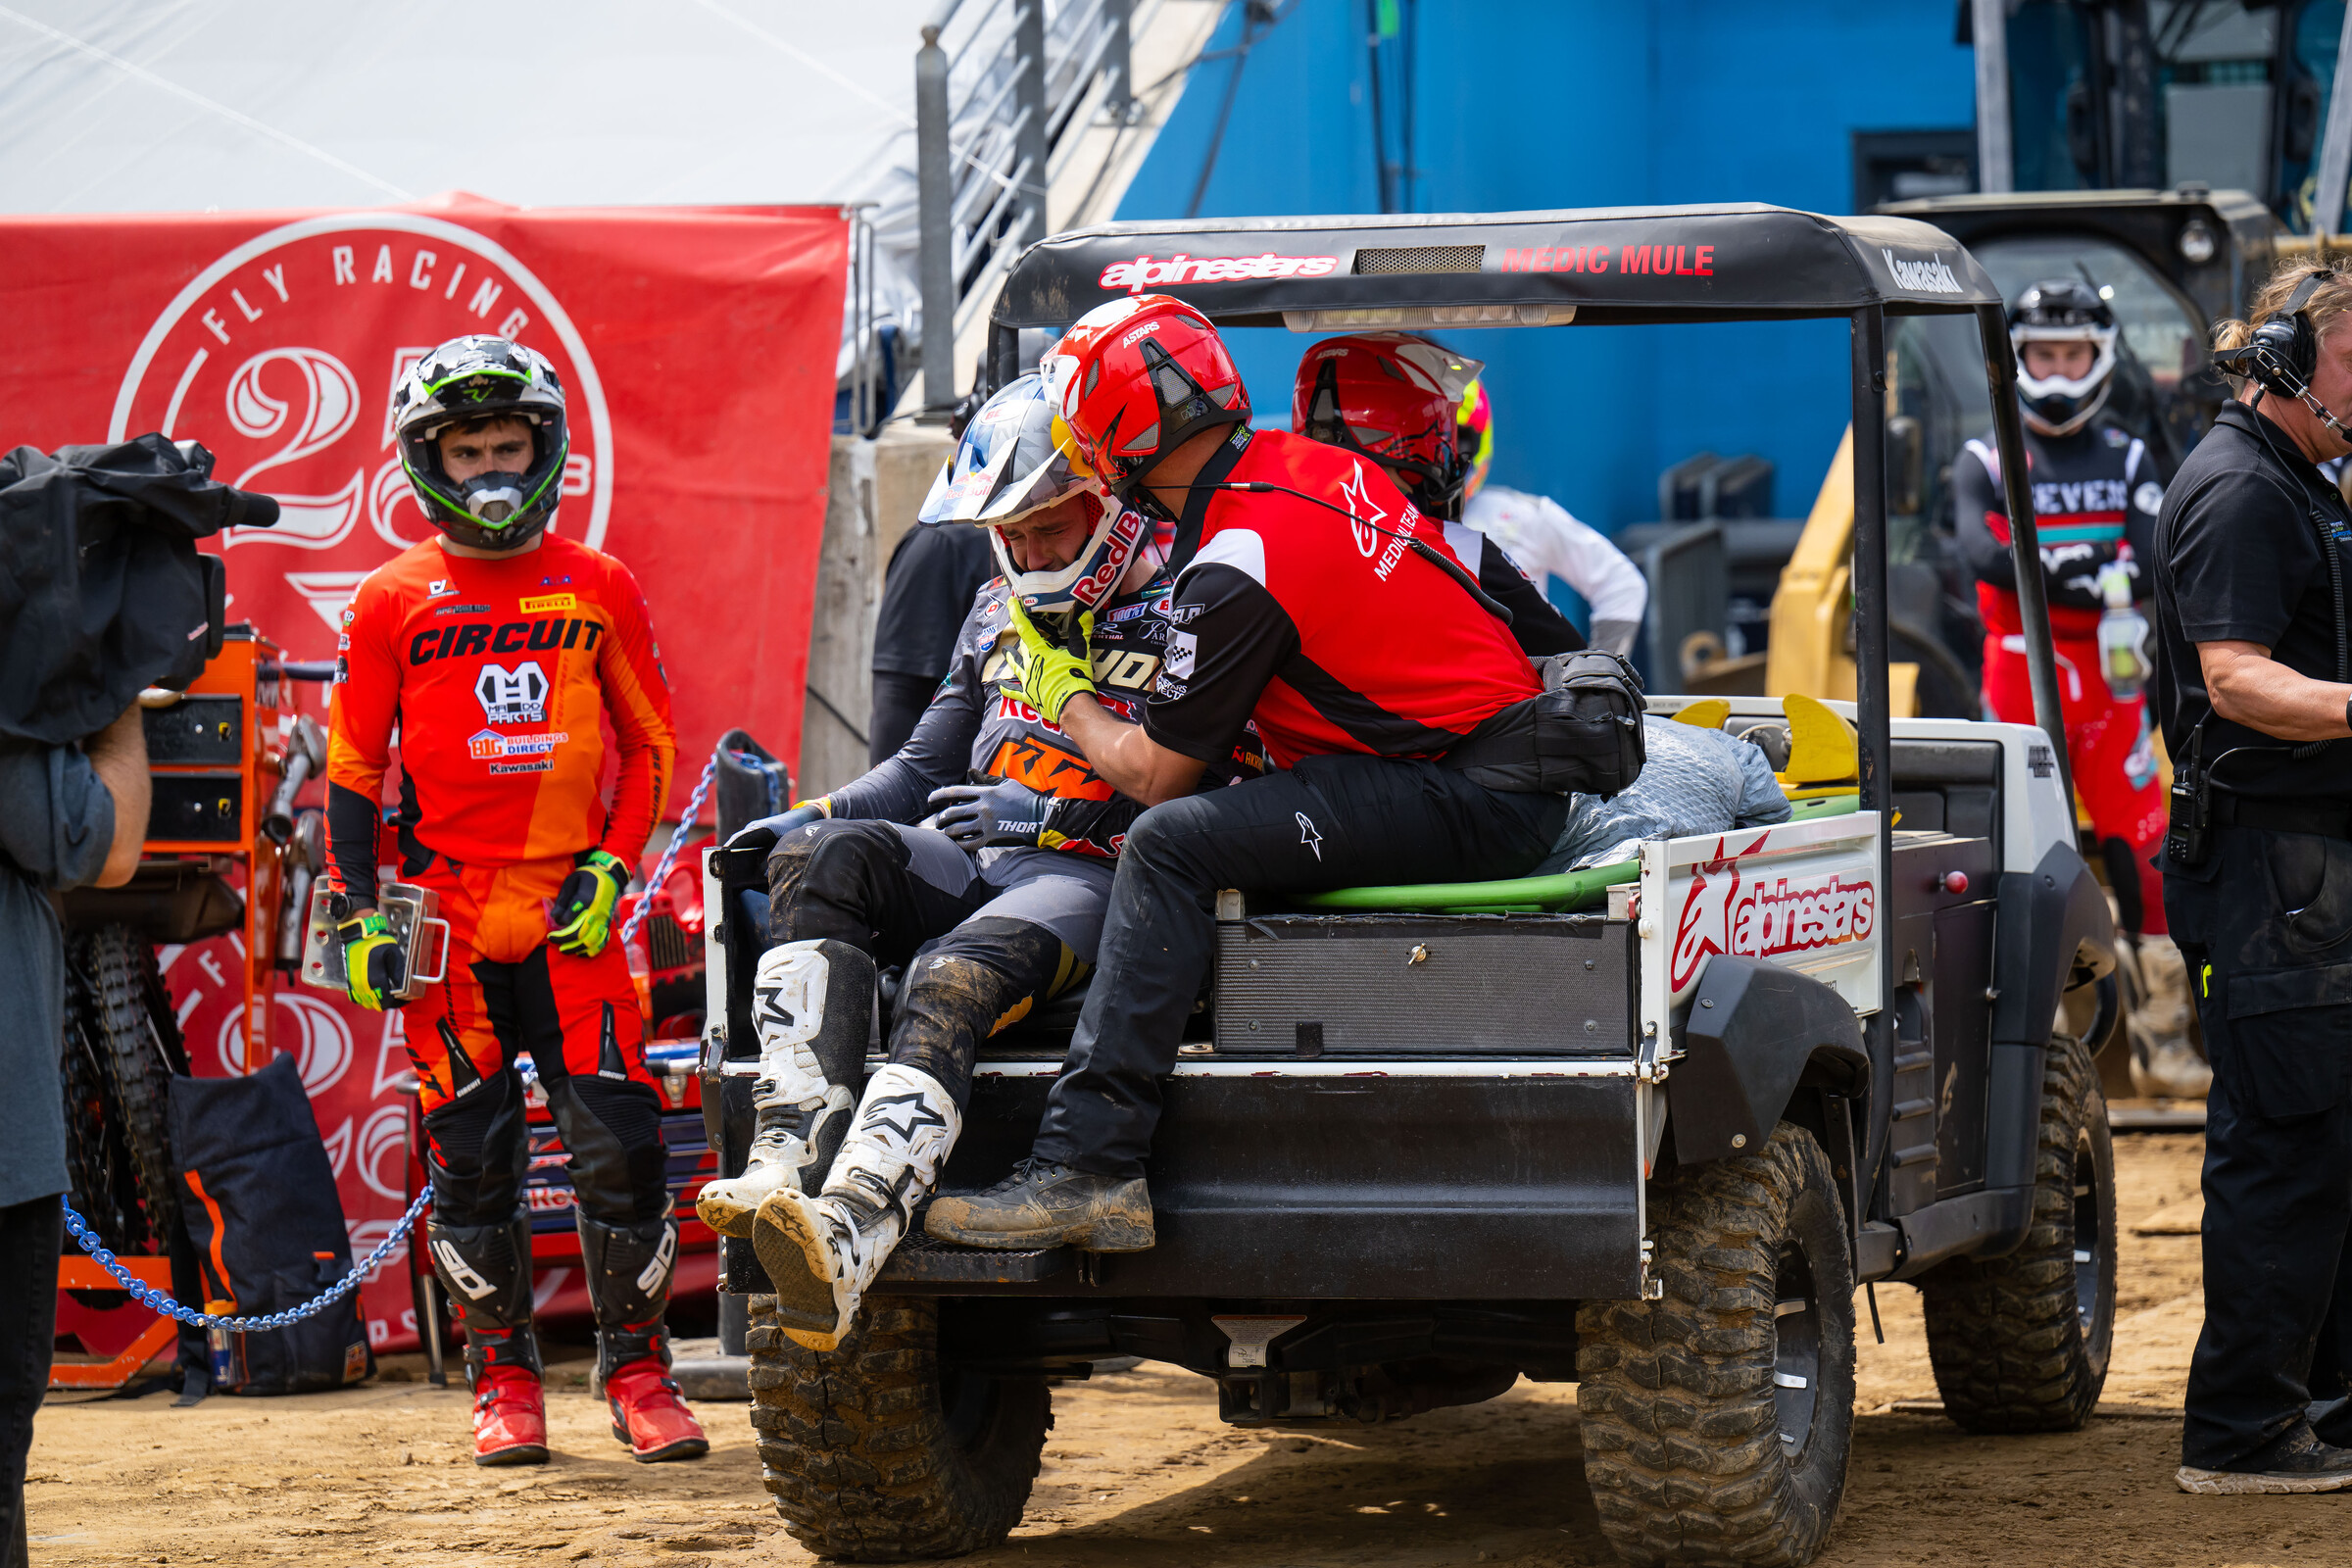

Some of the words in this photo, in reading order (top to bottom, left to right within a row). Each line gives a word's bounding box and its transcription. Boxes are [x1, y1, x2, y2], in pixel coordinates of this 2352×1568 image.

[1100, 252, 1340, 295] alpinestars
[1501, 245, 1610, 274] MEDIC
[1620, 244, 1715, 277] MULE
[1882, 248, 1964, 295] Kawasaki
[202, 264, 289, 345] FLY
[332, 244, 530, 342] RACING
[1122, 321, 1160, 349] ASTARS
[2032, 479, 2128, 514] EVEN
[1374, 524, 1411, 582] MEDICAL
[1400, 502, 1419, 530] TEAM
[524, 597, 571, 610] PIRELLI
[410, 619, 605, 665] CIRCUIT
[487, 710, 542, 725] PARTS
[507, 732, 568, 745] BUILDINGS
[508, 743, 554, 755] DIRECT
[490, 760, 554, 774] Kawasaki
[997, 820, 1044, 834] THOR
[1733, 874, 1876, 960] alpinestars
[456, 1077, 482, 1099] CIRCUIT
[598, 1069, 627, 1082] CIRCUIT
